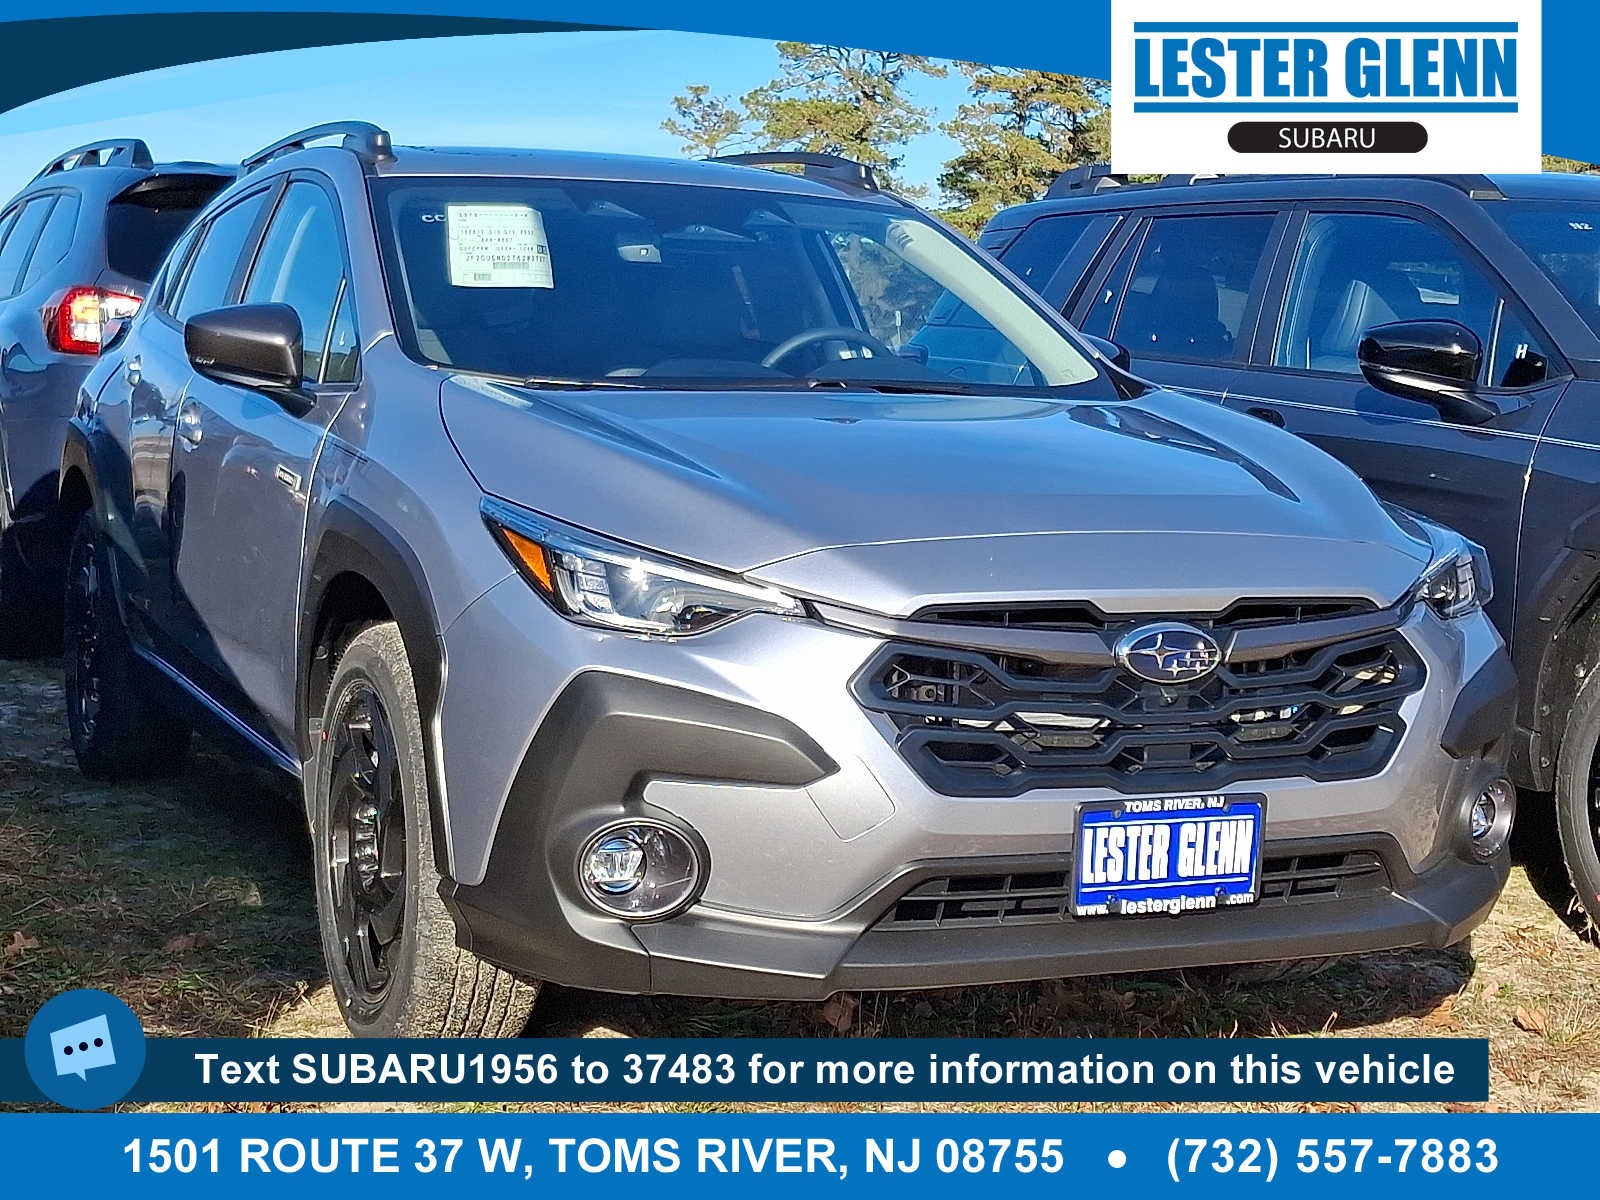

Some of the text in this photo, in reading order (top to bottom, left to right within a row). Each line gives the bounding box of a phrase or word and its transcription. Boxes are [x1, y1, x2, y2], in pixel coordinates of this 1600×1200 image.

[1124, 799, 1161, 813] TOMS
[1207, 796, 1225, 808] NJ
[1082, 819, 1255, 884] LESTER GLENN
[1120, 894, 1217, 915] lesterglenn
